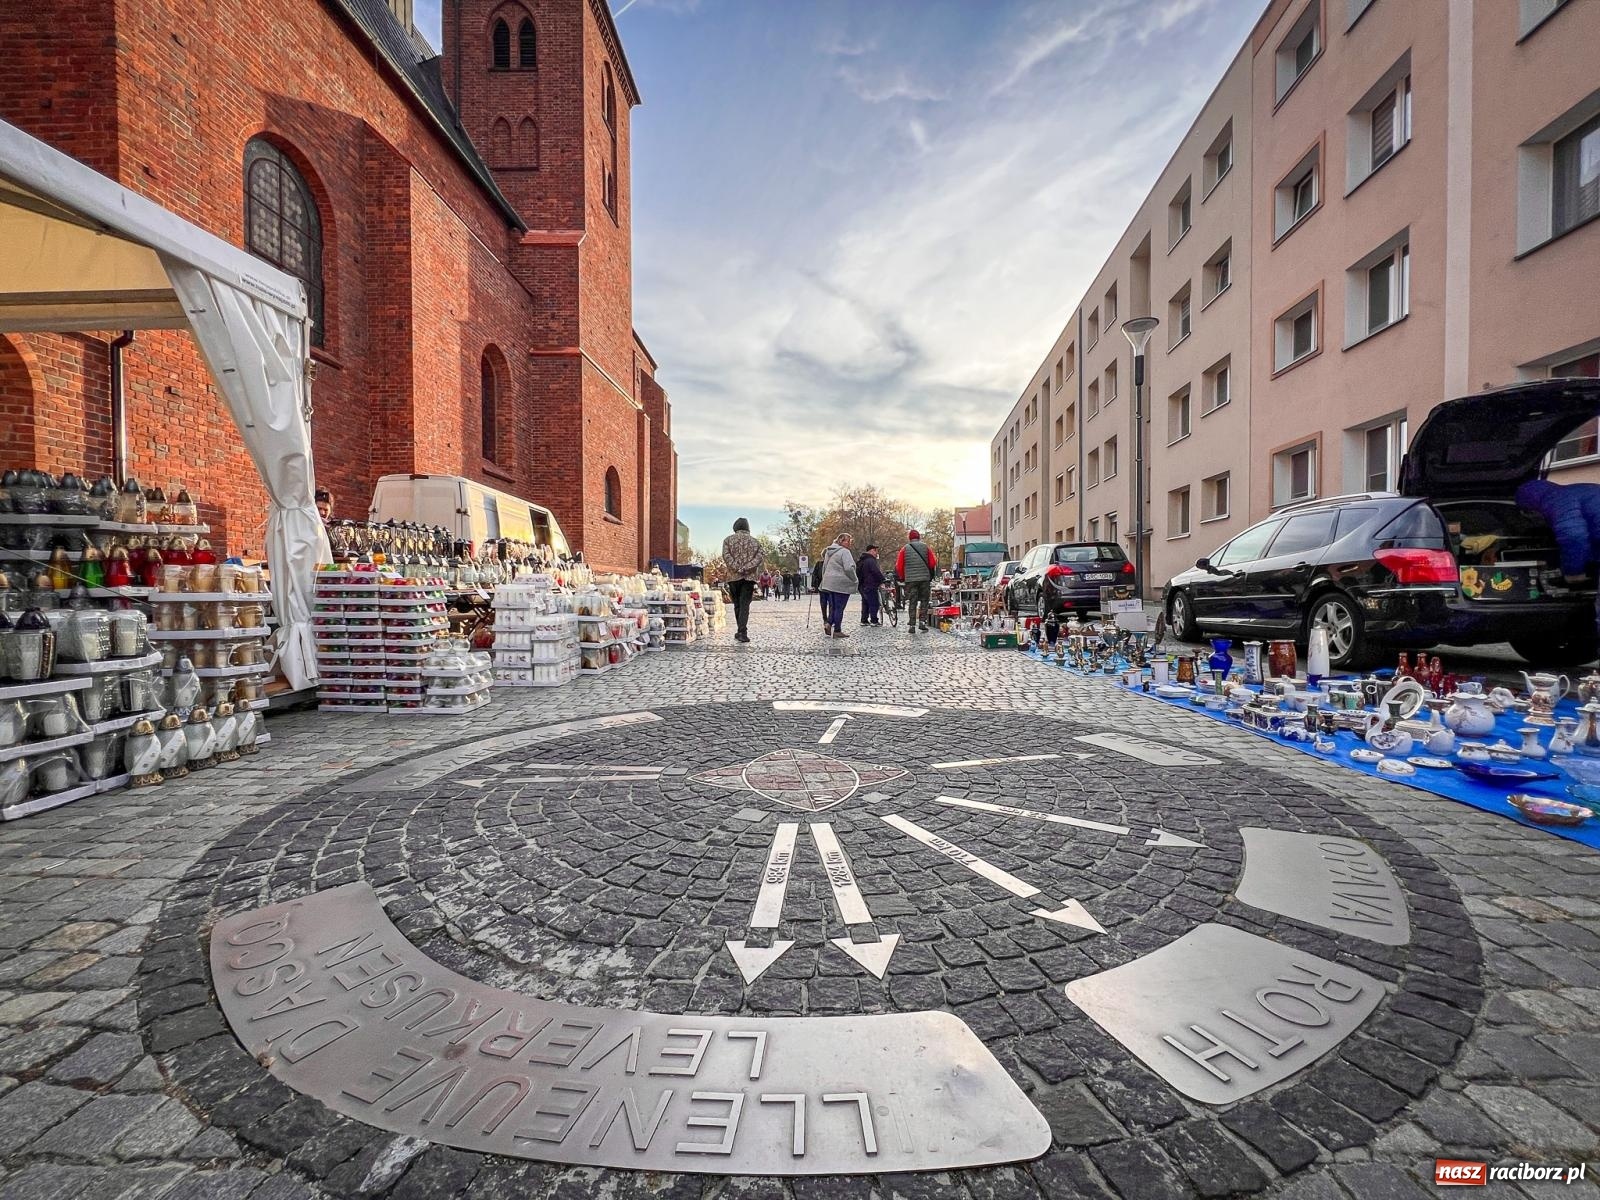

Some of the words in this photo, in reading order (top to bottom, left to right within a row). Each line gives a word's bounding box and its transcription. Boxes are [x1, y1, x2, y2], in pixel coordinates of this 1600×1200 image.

[811, 794, 835, 804] W
[928, 838, 952, 851] km
[771, 852, 790, 865] km
[826, 851, 843, 865] km
[946, 850, 978, 866] 710
[766, 867, 786, 884] 984
[828, 866, 852, 888] 1284
[1319, 842, 1394, 926] OPAVA
[226, 911, 360, 1065] D'ASCQ
[316, 929, 768, 1081] LEVERKUSEN
[1162, 962, 1363, 1084] ROTH
